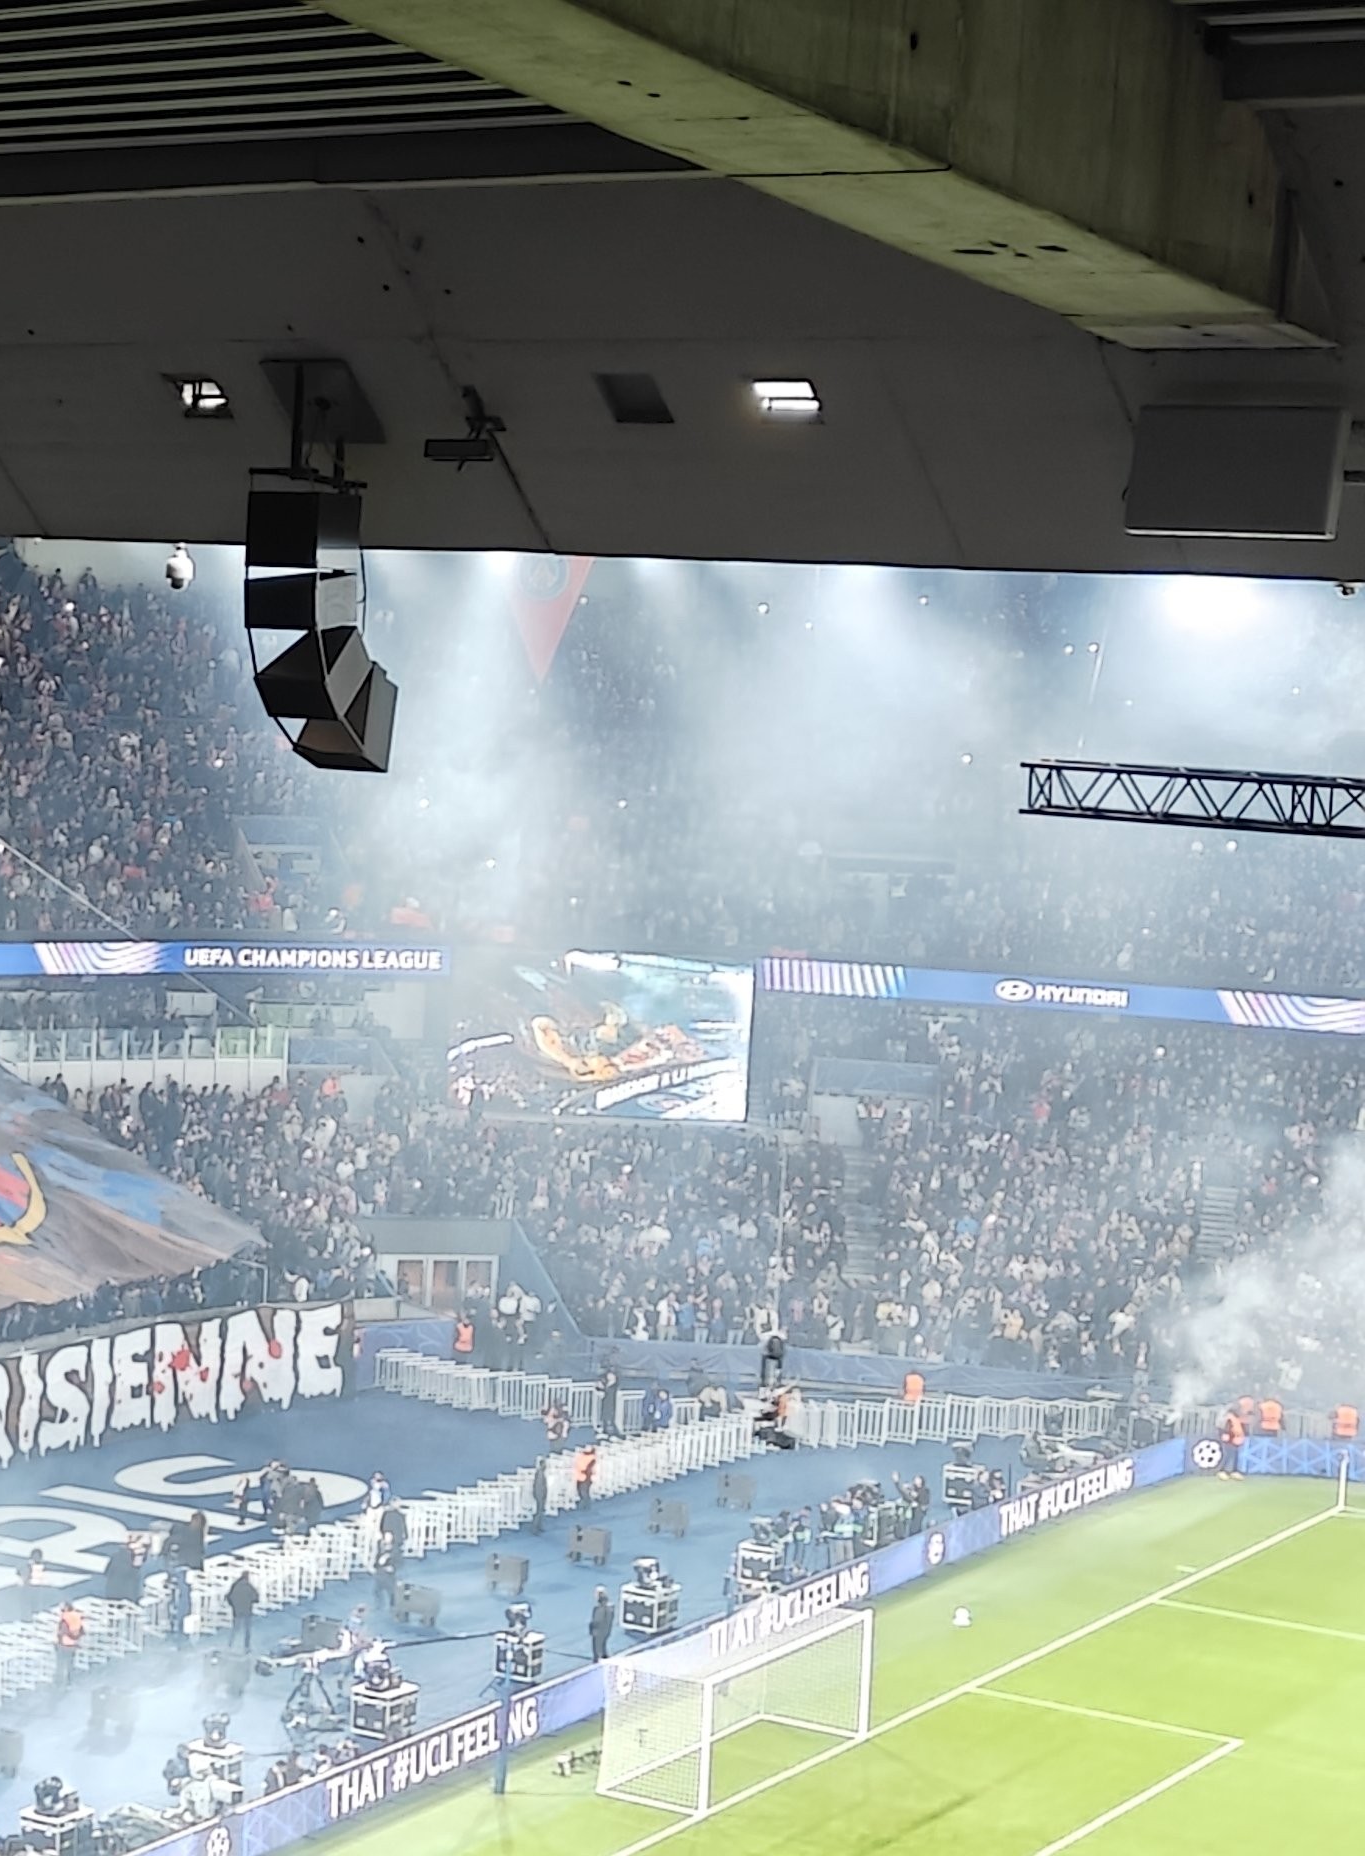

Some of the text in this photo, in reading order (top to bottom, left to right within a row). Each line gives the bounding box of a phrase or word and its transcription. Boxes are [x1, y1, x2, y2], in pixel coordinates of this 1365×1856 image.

[183, 947, 442, 970] UEFA CHAMPIONS LEAGUE
[1035, 983, 1130, 1008] HYUNDAI
[999, 1492, 1039, 1537] THAT
[326, 1696, 540, 1819] THAT #UCLFEELNG
